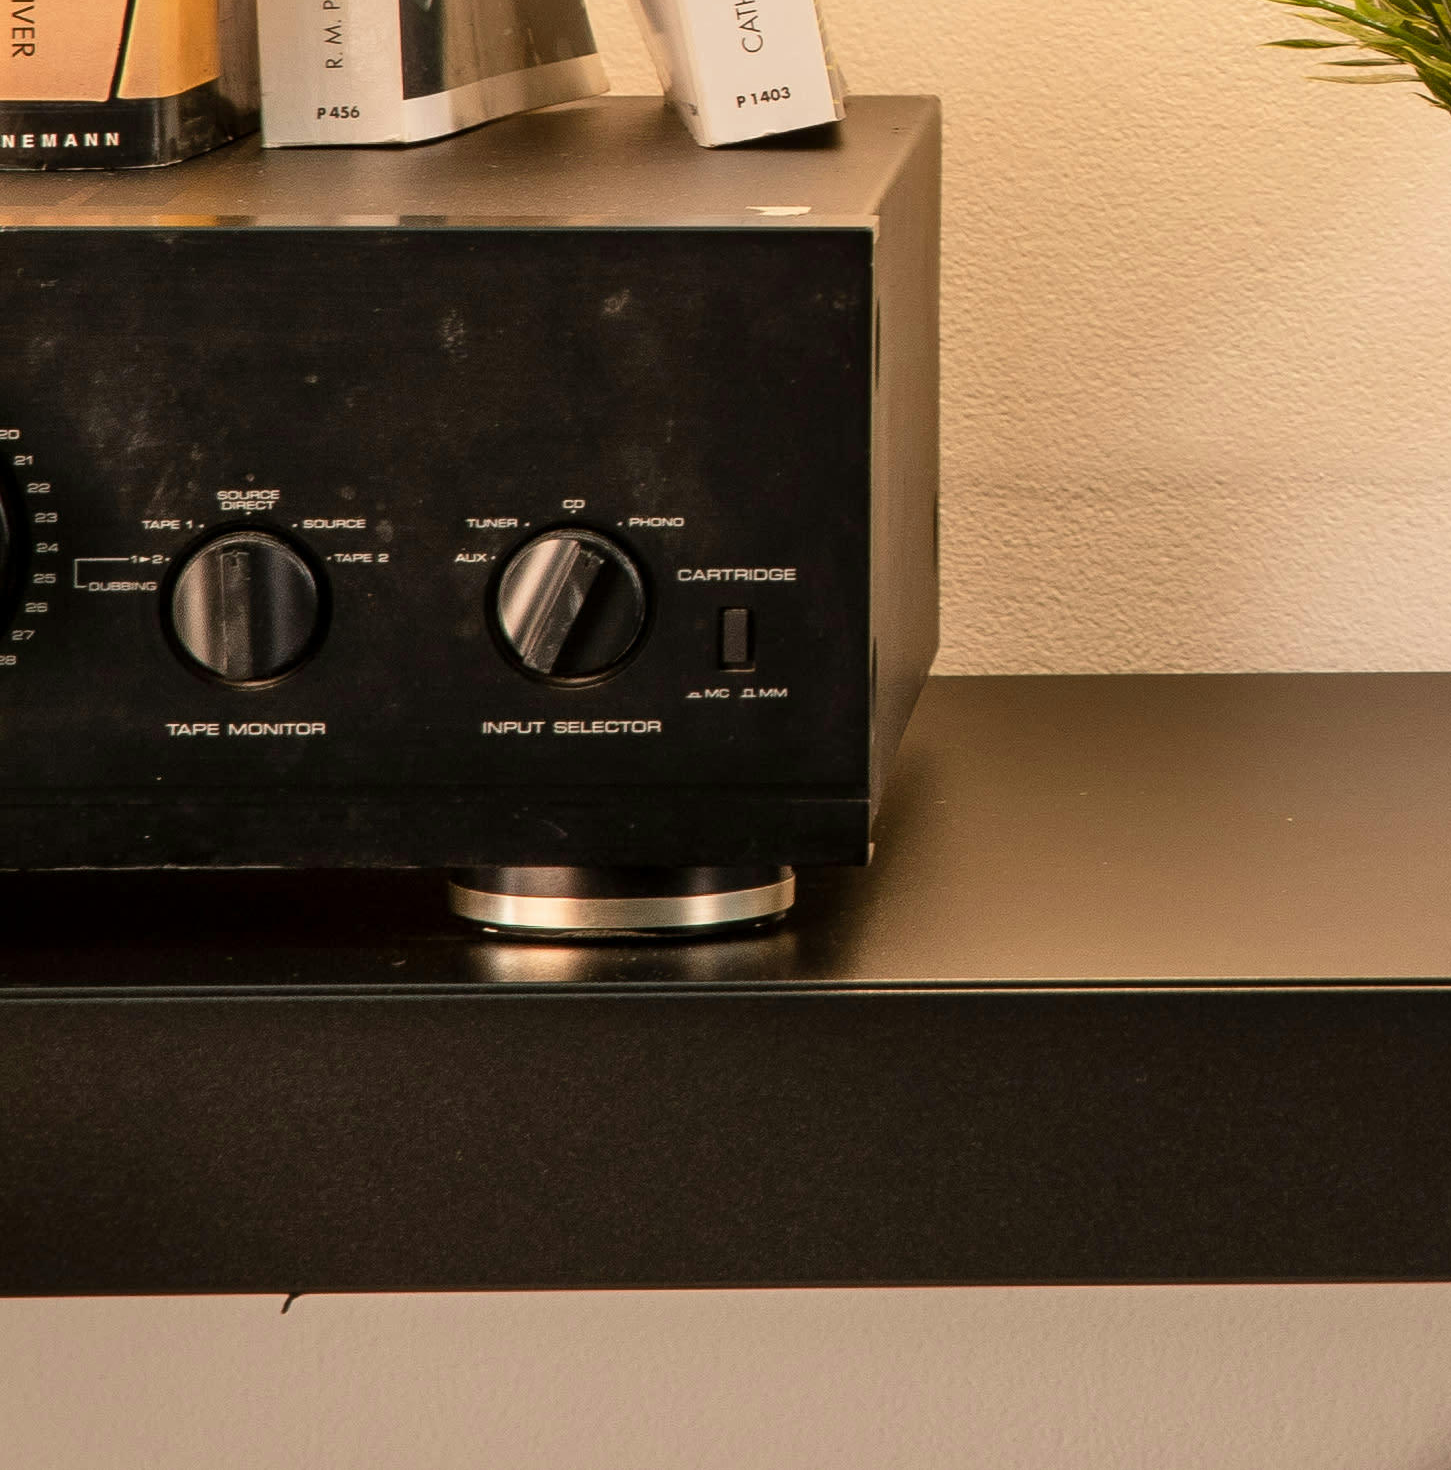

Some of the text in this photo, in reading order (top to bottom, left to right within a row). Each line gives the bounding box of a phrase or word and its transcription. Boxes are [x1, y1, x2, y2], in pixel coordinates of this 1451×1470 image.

[325, 18, 344, 46] M.
[325, 52, 344, 69] R.
[736, 86, 791, 108] P 1403
[316, 106, 360, 120] P 456
[1, 132, 121, 149] NEMANN
[13, 455, 34, 466] 21
[27, 482, 51, 493] 22
[216, 489, 281, 501] SOURCE
[220, 501, 276, 511] DIRECT
[562, 498, 586, 510] CD
[34, 512, 58, 523] 23
[629, 517, 685, 528] PHONO
[141, 519, 194, 530] TAPE 1
[302, 518, 367, 530] SOURCE
[466, 518, 518, 529] TUNER
[36, 543, 59, 553] 24
[335, 553, 389, 563] TAPE 2
[455, 553, 488, 563] AUX
[33, 573, 57, 584] 25
[678, 568, 797, 582] CARTRIDGE
[88, 581, 158, 592] DUBBING
[25, 602, 48, 613] 26
[12, 629, 36, 641] 27
[705, 688, 788, 699] MC MM
[165, 722, 327, 737] TAPE MONITOR
[482, 721, 662, 735] INPUT SELECTOR
